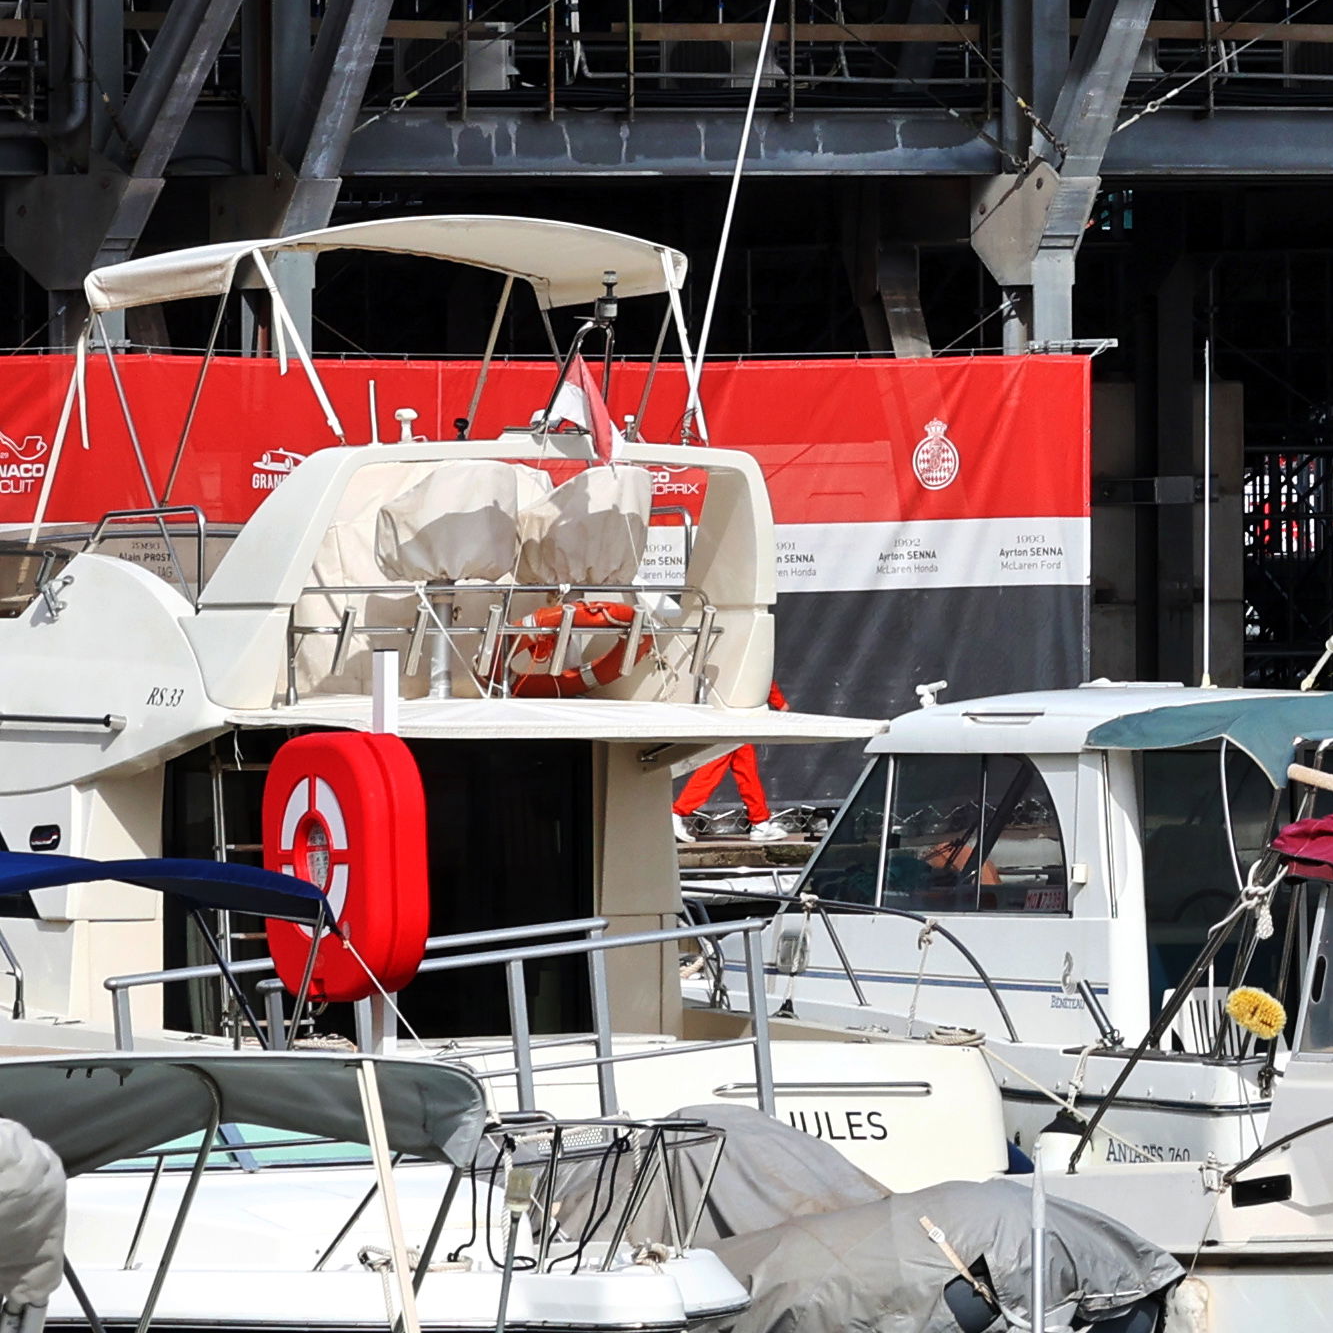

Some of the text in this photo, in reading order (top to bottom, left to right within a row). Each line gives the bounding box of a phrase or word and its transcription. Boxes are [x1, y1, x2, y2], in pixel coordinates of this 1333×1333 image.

[878, 550, 936, 562] Ayrton SENNA
[999, 547, 1063, 558] Ayrton SENNA
[658, 555, 685, 565] SENN
[784, 555, 815, 564] SENNA
[1000, 560, 1061, 571] McLaren Ford
[146, 687, 184, 707] RS 33
